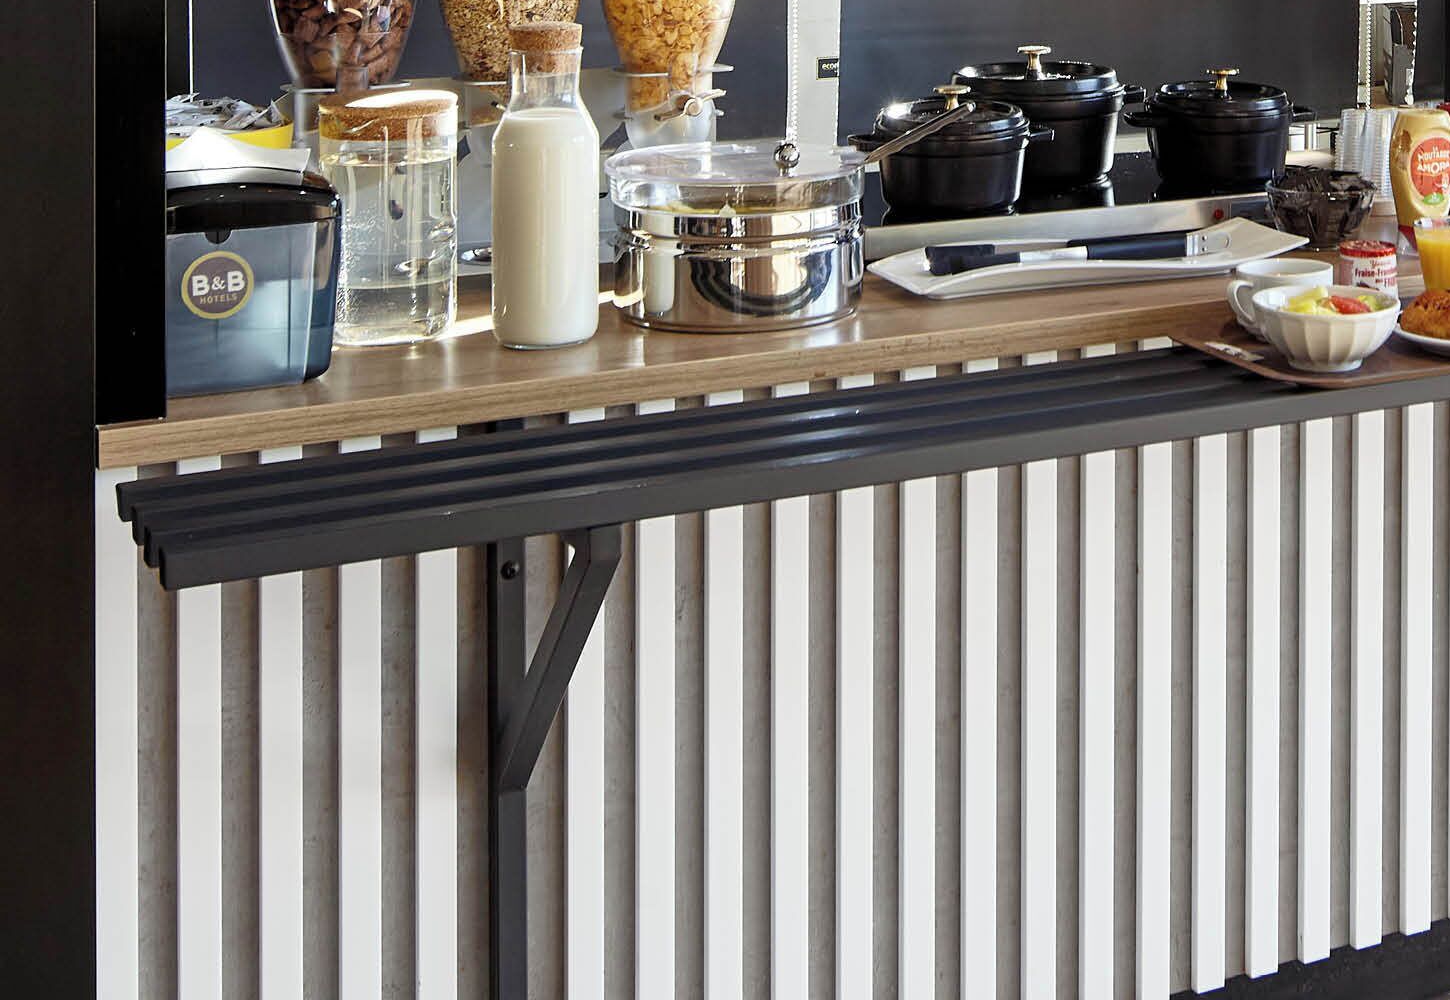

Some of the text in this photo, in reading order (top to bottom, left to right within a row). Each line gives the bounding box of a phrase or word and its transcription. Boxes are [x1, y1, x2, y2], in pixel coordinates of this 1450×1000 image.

[1417, 150, 1450, 162] MOUTARDE
[1417, 161, 1450, 174] AMORA
[192, 270, 246, 297] B&B
[200, 294, 238, 305] HOTELS
